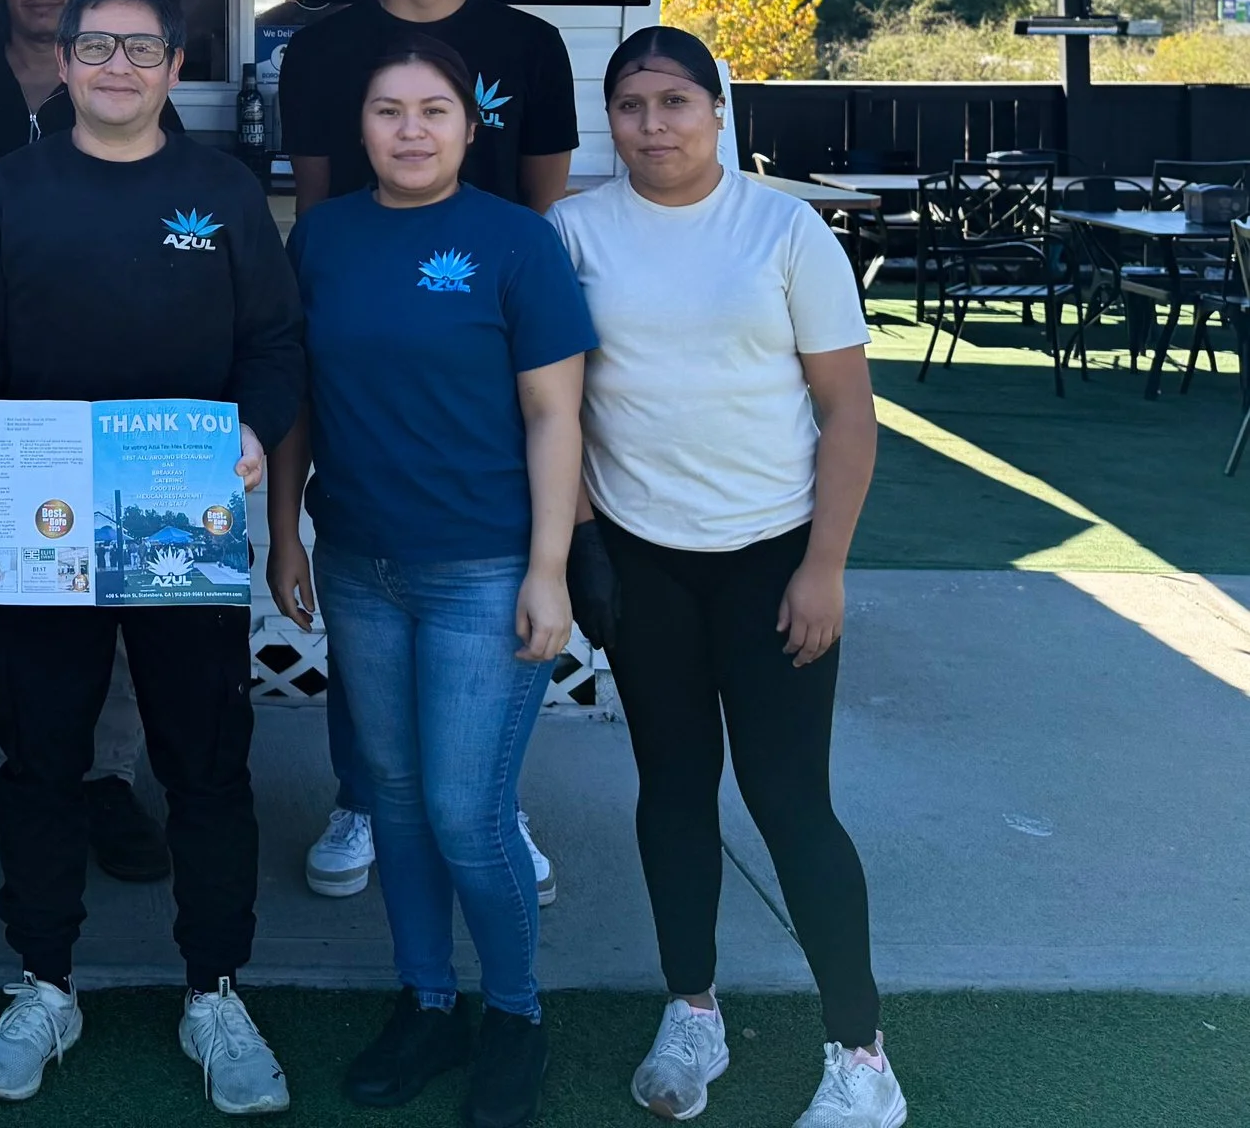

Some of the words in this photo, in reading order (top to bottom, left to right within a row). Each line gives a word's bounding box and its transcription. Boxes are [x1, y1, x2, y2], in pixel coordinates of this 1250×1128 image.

[263, 29, 276, 37] We
[242, 124, 264, 134] BUD
[163, 233, 216, 251] AZUL
[417, 276, 470, 292] AZUL
[98, 412, 179, 433] THANK
[186, 412, 233, 433] YOU
[42, 508, 63, 518] Best
[150, 575, 193, 588] AZUL
